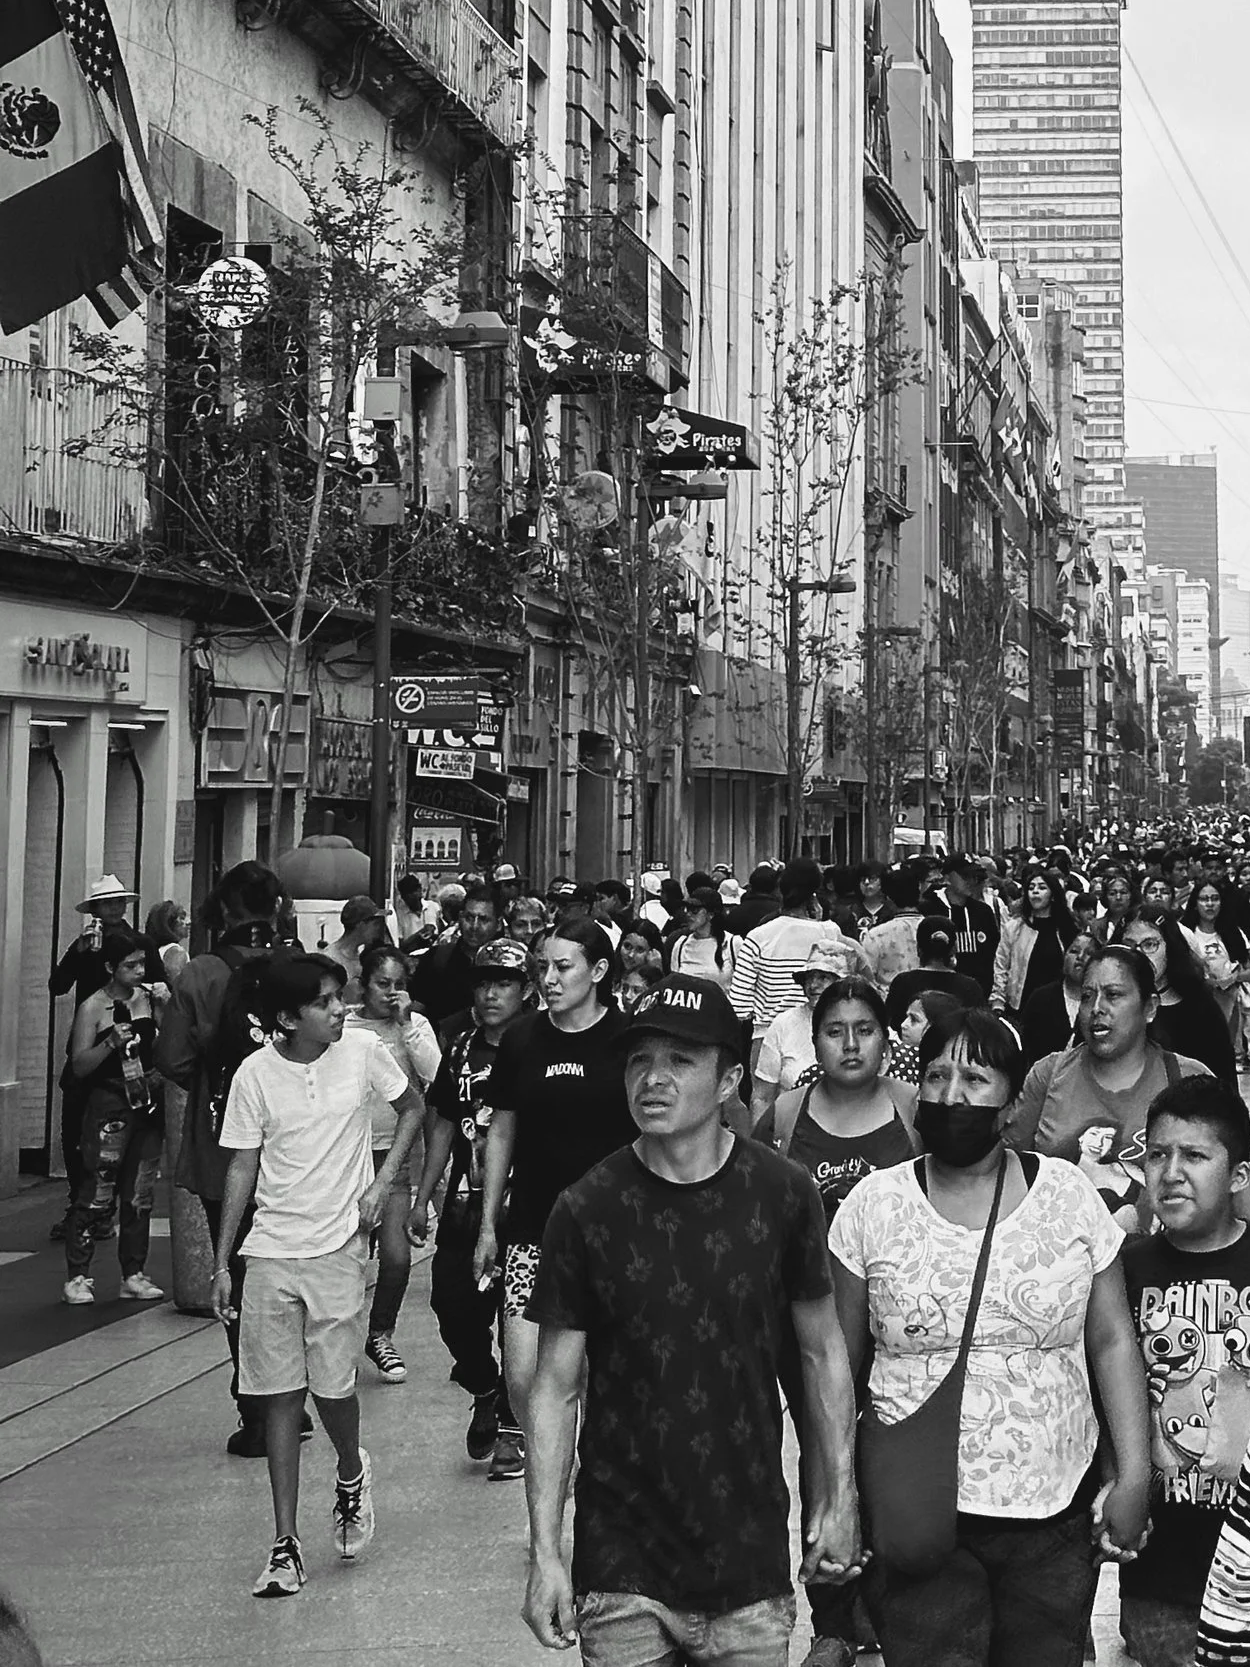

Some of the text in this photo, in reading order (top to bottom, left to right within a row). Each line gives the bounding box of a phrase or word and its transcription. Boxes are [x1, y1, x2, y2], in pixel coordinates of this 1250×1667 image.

[692, 432, 742, 448] Pirates
[420, 752, 440, 769] WC
[817, 1158, 862, 1178] Gravity
